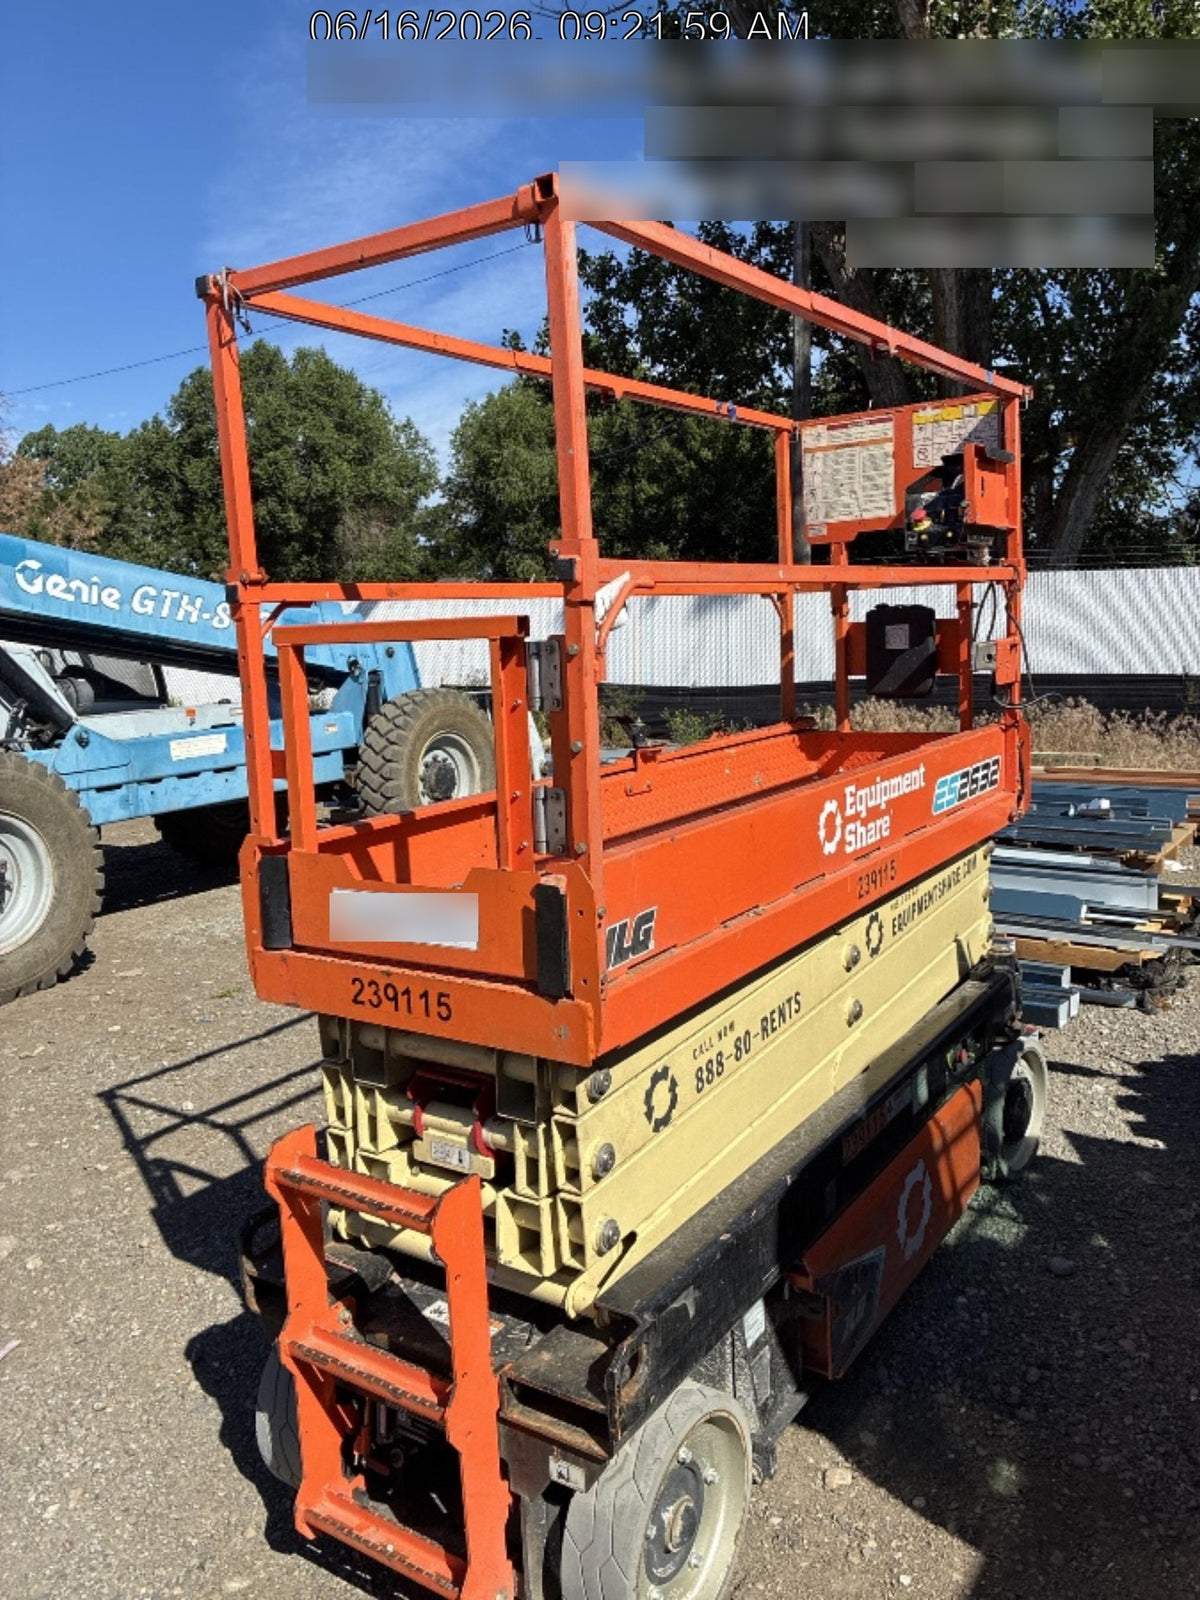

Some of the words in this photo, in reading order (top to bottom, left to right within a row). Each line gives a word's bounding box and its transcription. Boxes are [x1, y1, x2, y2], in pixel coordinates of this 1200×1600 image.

[15, 559, 122, 611] Genie
[845, 763, 925, 818] Equipment
[932, 755, 1001, 816] ES2632
[845, 815, 890, 854] Share
[857, 860, 897, 900] 239115
[606, 904, 657, 971] JLG
[351, 977, 453, 1022] 239115
[693, 1036, 713, 1060] CALL
[694, 991, 802, 1094] 888-80-RENTS
